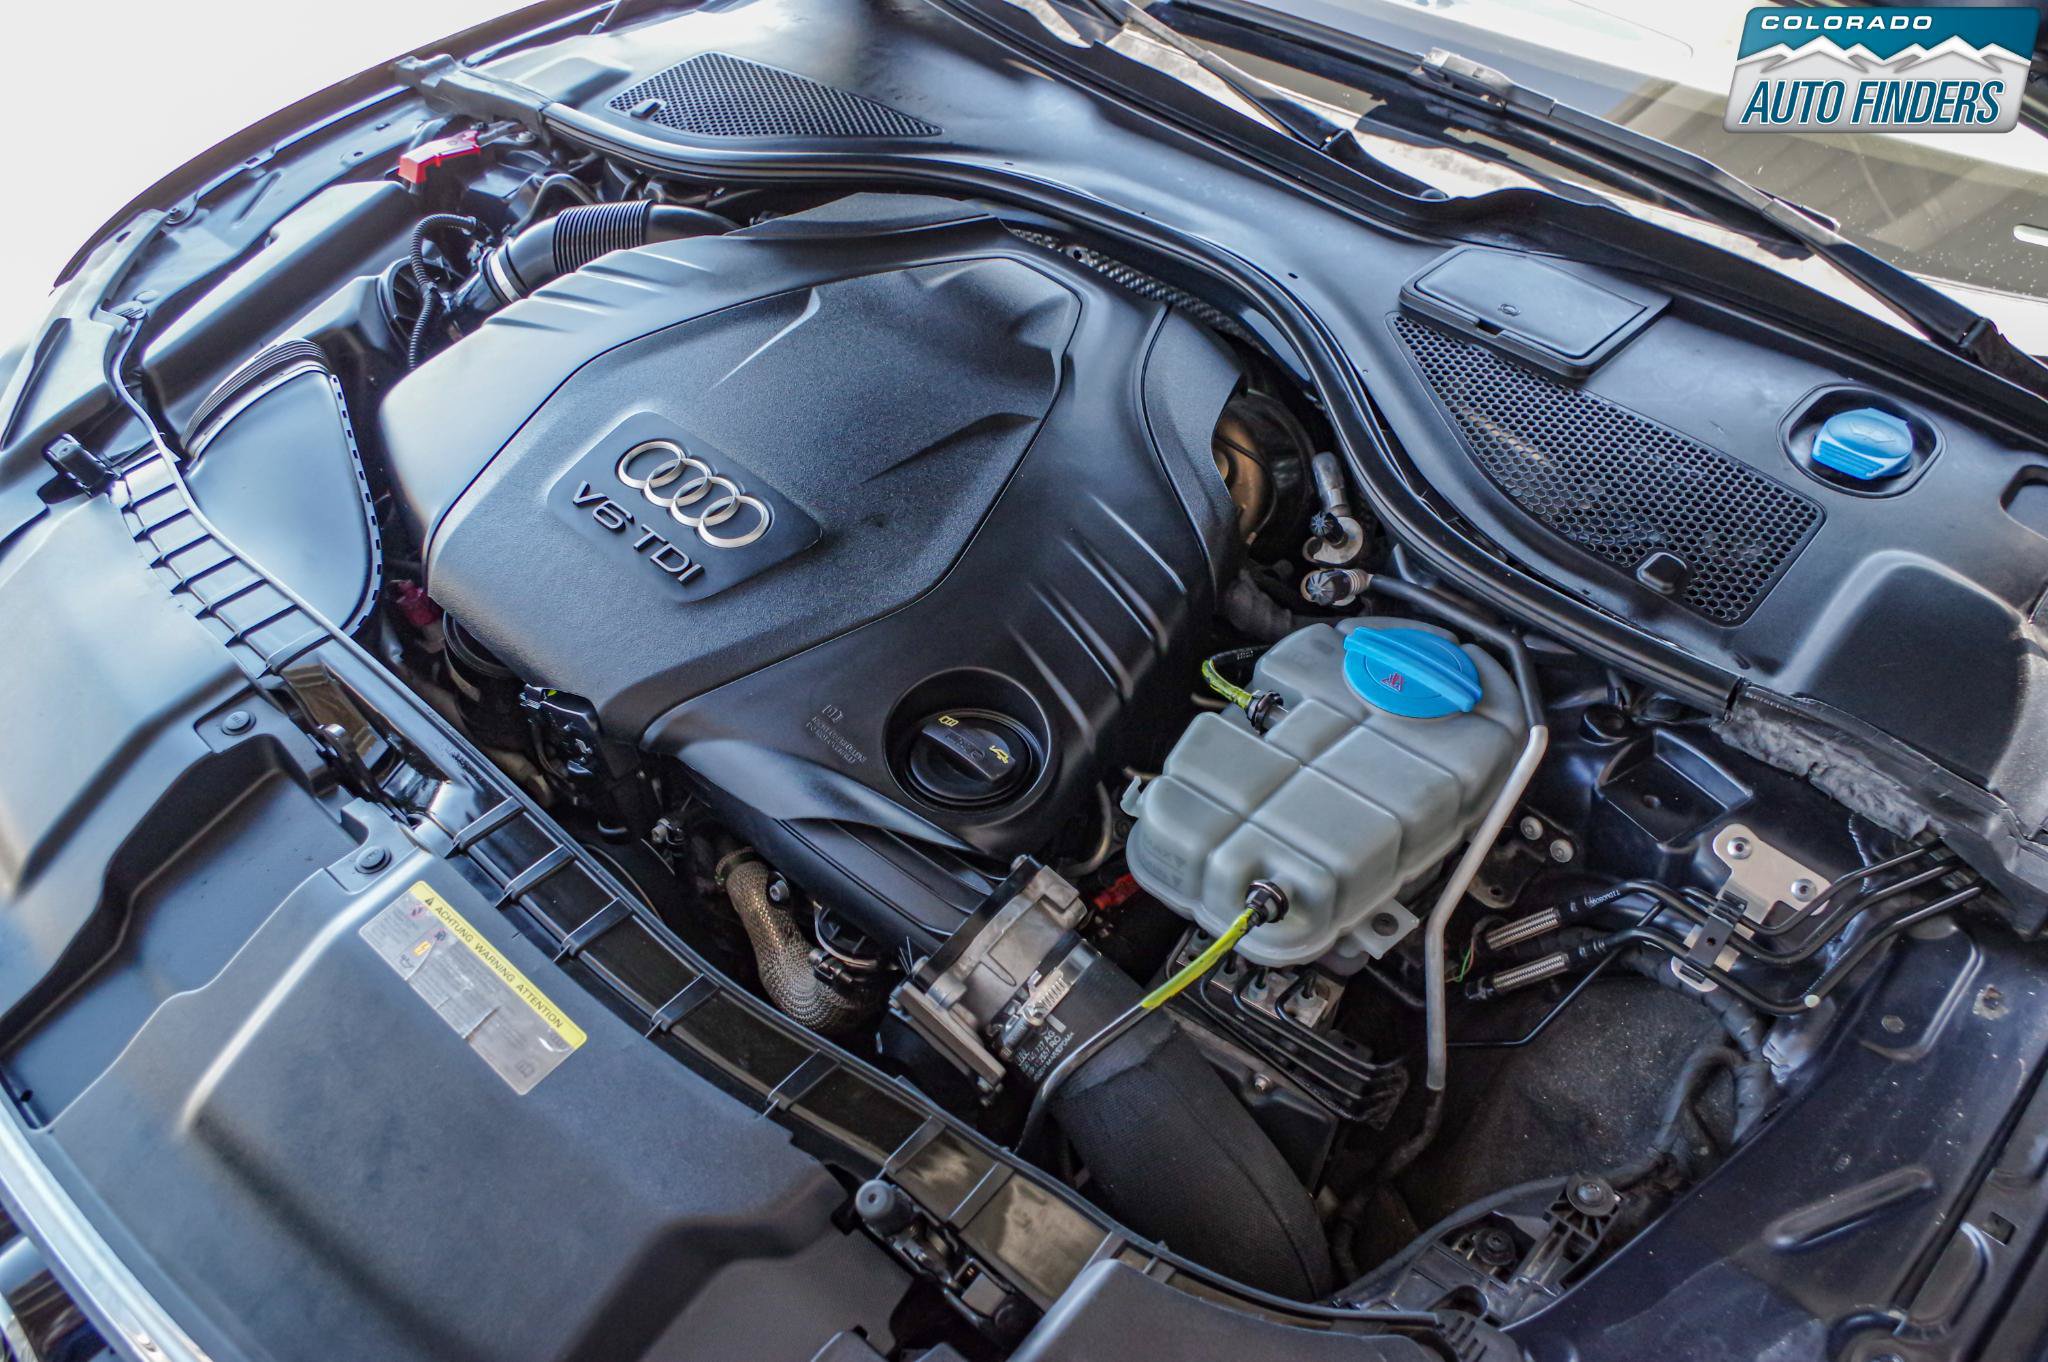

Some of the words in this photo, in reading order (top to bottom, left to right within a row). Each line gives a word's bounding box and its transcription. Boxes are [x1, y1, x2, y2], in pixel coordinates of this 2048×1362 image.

[573, 480, 634, 531] V6
[633, 523, 704, 584] TDI
[435, 906, 474, 943] ACHTUNG
[475, 943, 516, 983] WARNING
[516, 983, 564, 1029] ATTENTION
